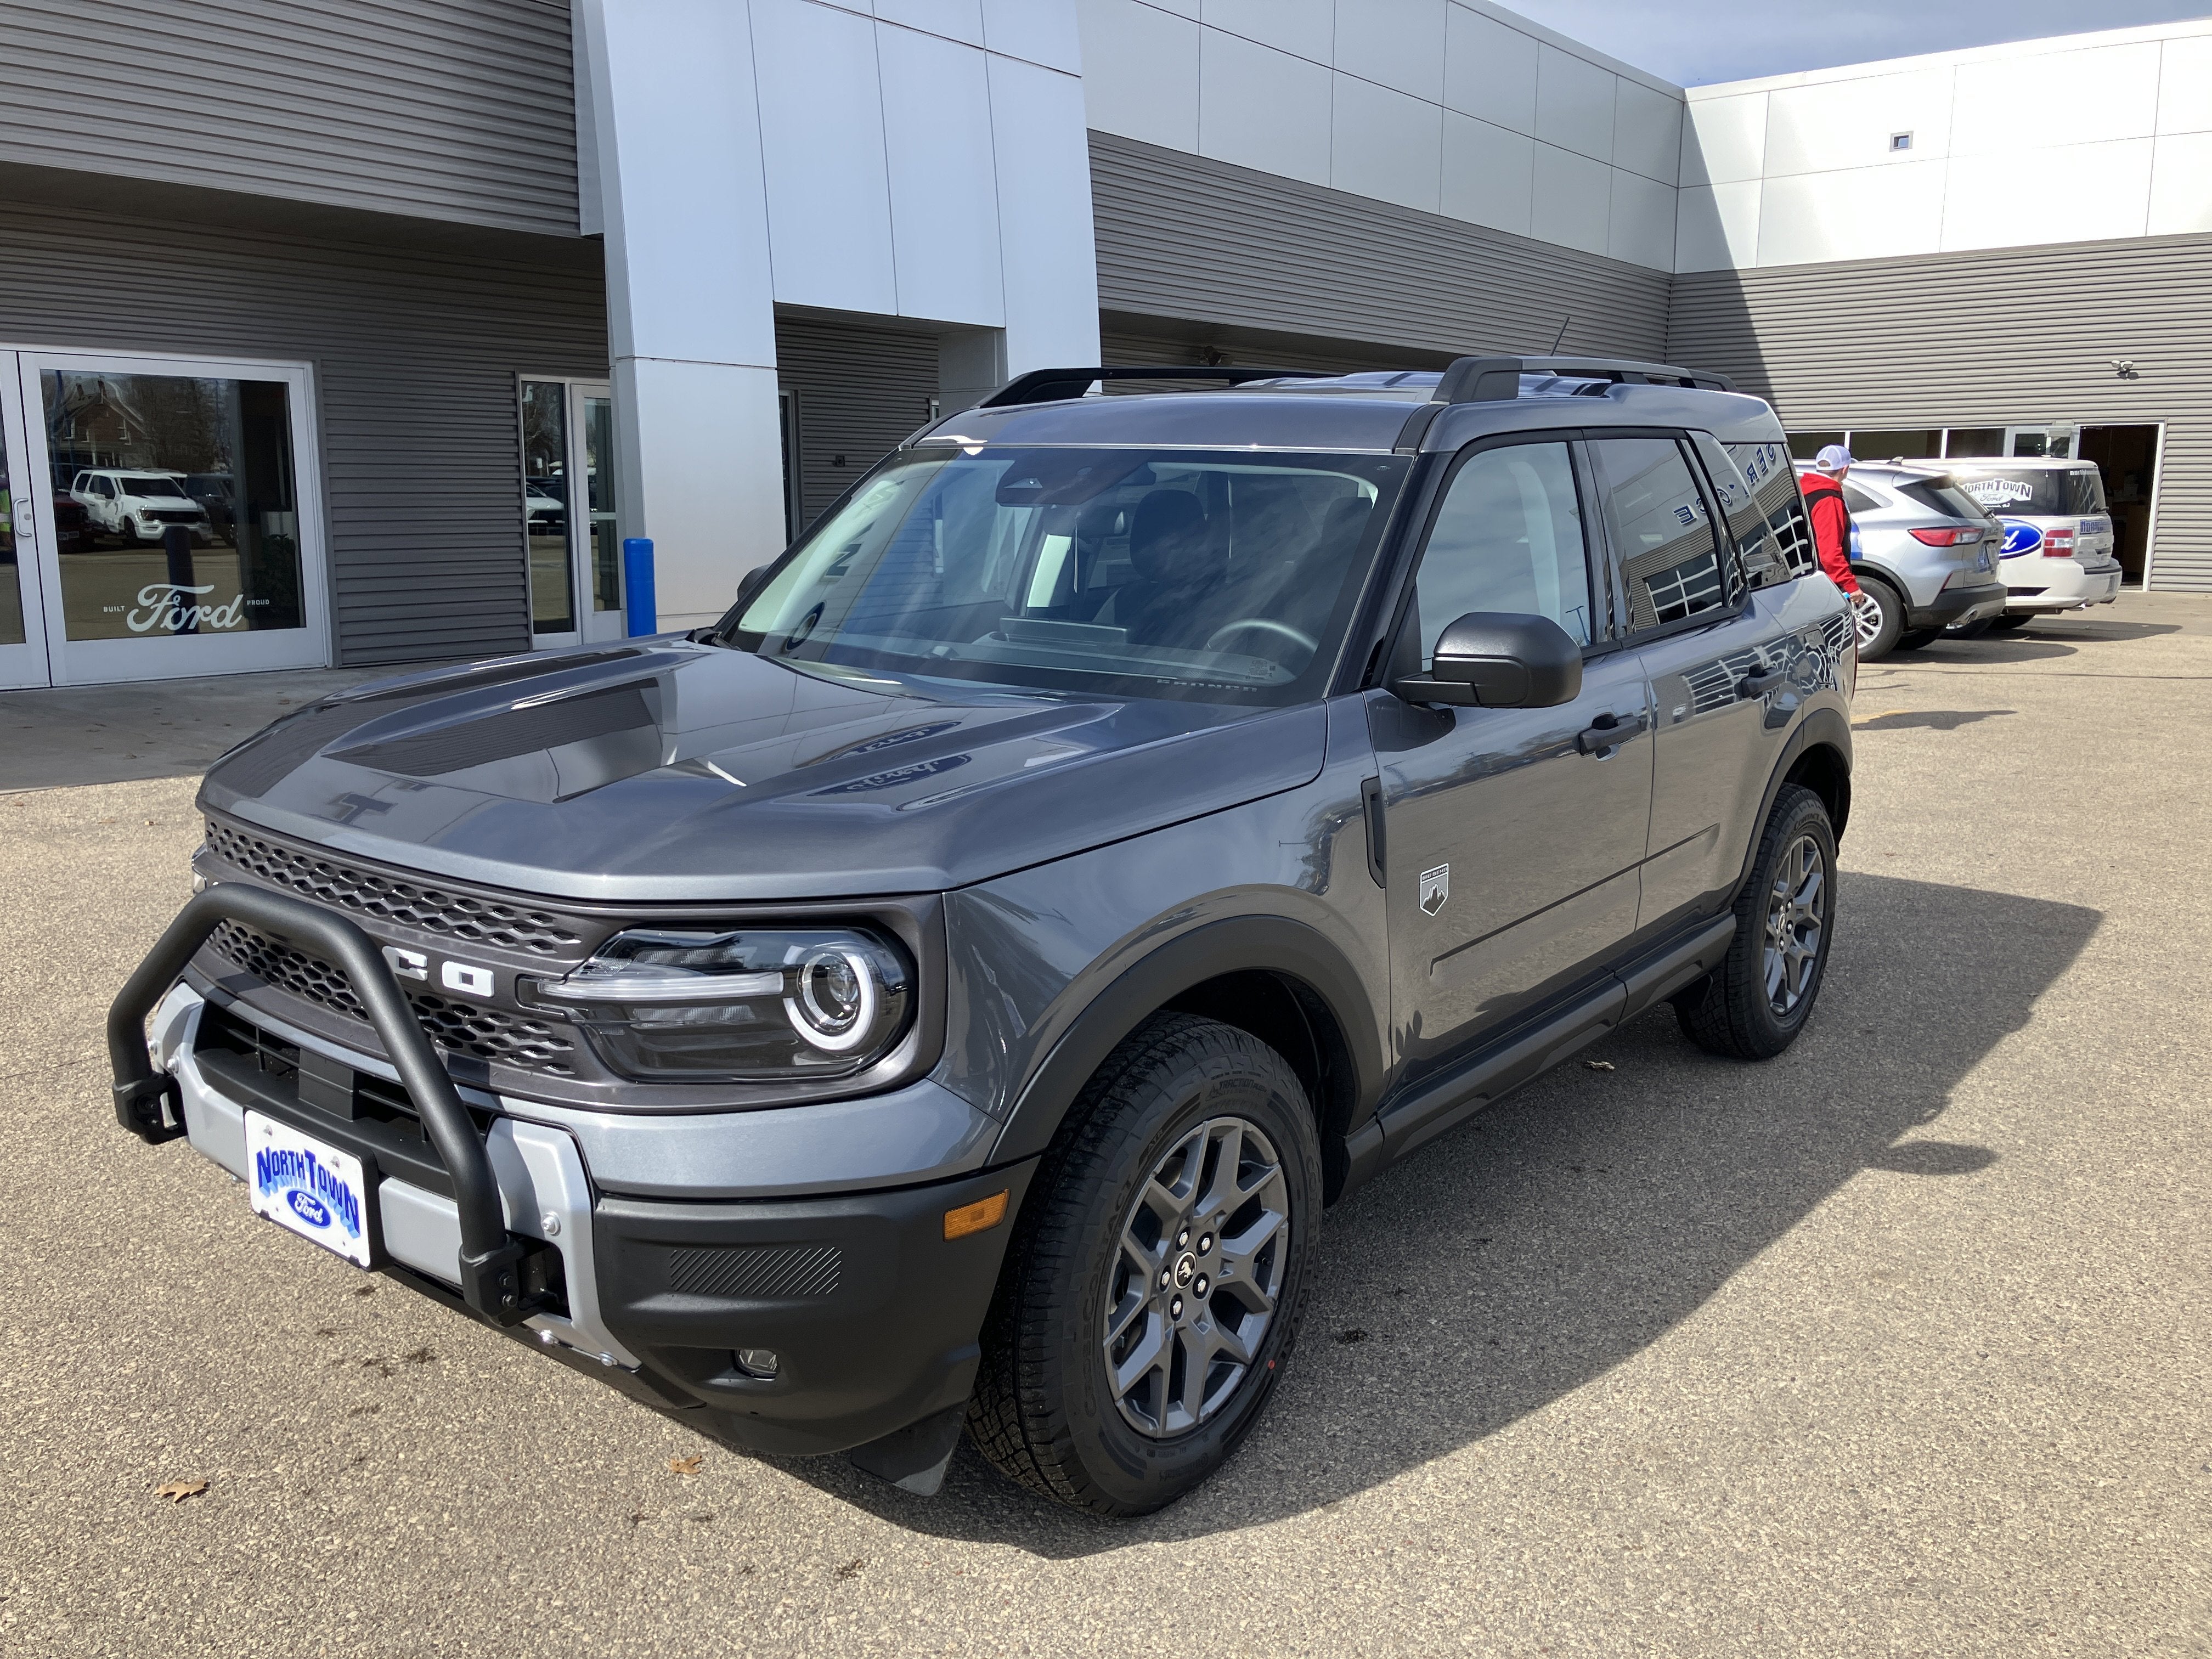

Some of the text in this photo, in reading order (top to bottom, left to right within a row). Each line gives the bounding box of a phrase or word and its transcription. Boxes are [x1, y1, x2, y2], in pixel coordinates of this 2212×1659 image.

[126, 583, 244, 632] Ford
[1432, 867, 1447, 877] BEND
[295, 1192, 324, 1223] Ford
